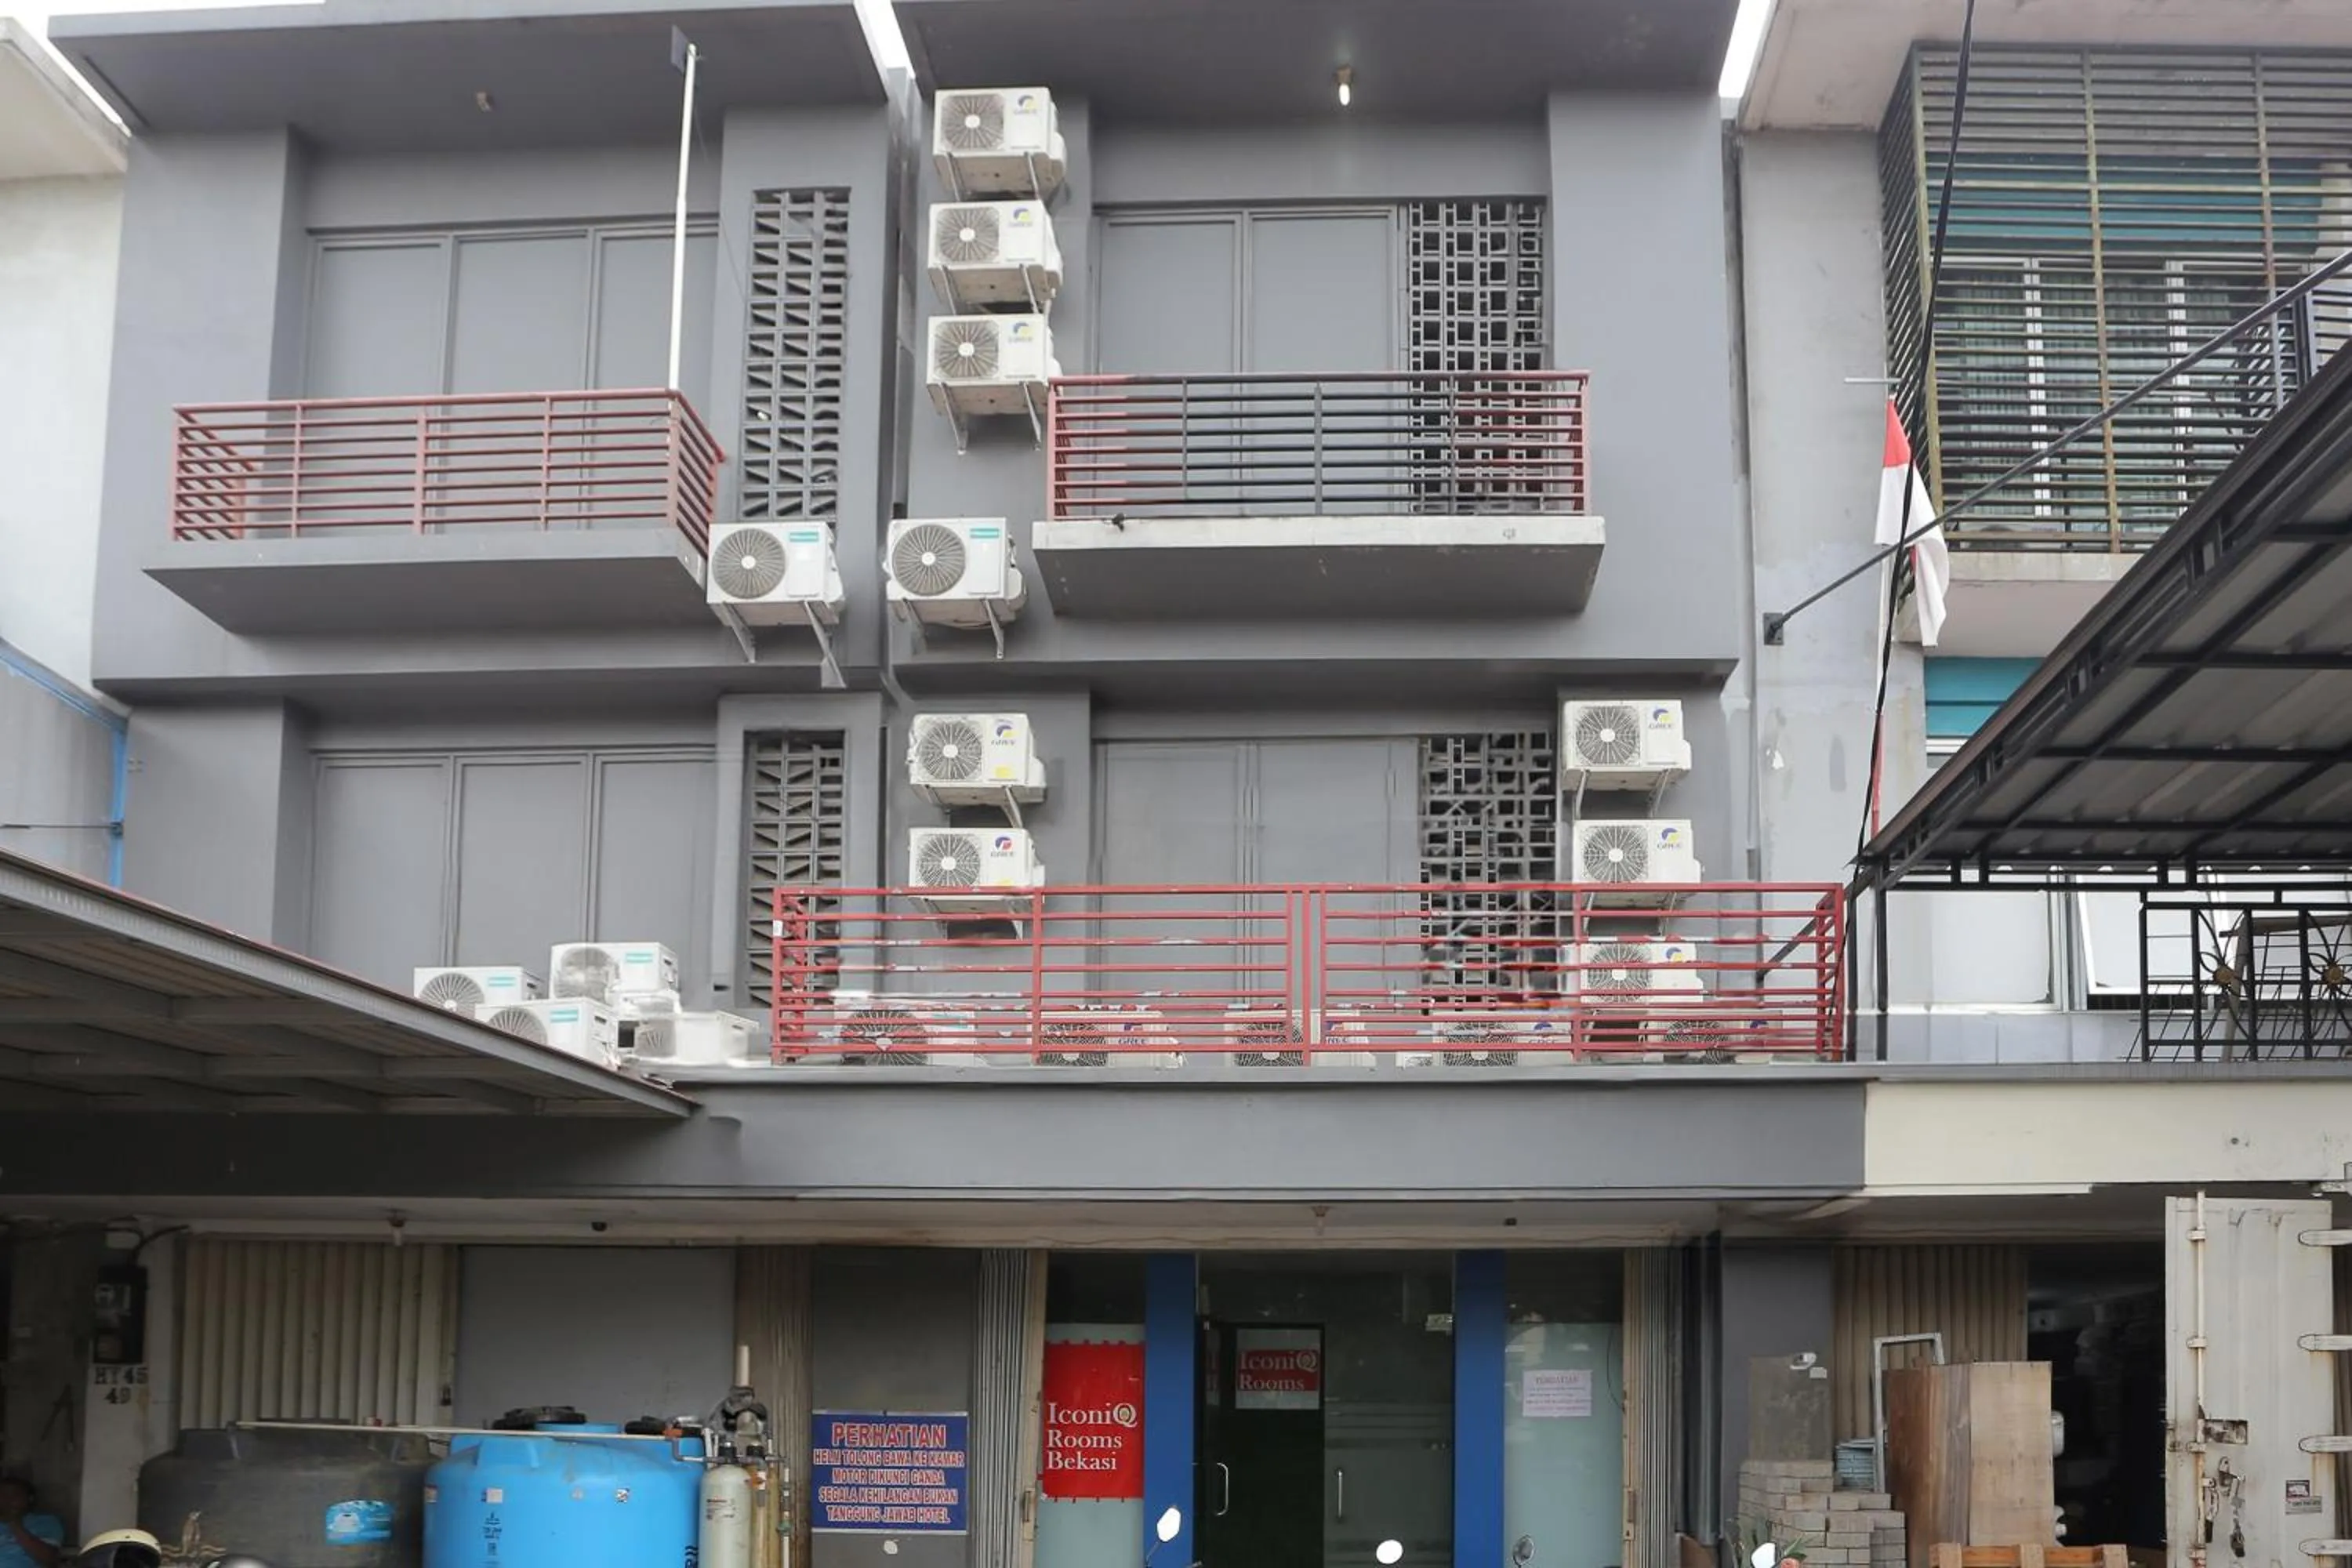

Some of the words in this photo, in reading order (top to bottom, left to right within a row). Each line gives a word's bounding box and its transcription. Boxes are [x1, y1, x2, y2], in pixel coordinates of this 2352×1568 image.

[1240, 1350, 1318, 1372] IconiQ
[1240, 1374, 1305, 1391] Rooms
[1047, 1402, 1138, 1428] IconiQ
[832, 1422, 947, 1448] PERHATIAN
[1047, 1429, 1123, 1449] Rooms
[814, 1449, 840, 1465] HELM
[842, 1450, 881, 1465] TOLONG
[884, 1450, 911, 1466] BAWA
[911, 1451, 927, 1466] KE
[928, 1451, 964, 1468] KAMAR
[1047, 1450, 1117, 1470] Bekasi
[833, 1468, 868, 1484] MOTOR
[911, 1469, 946, 1486] GANDA
[818, 1486, 857, 1502] SEGALA
[858, 1486, 922, 1504] KEHILANGAN
[923, 1488, 958, 1504] BUKAN
[826, 1505, 880, 1521] TANGGUNG
[882, 1506, 916, 1522] JAWAB
[916, 1507, 951, 1523] HOTEL
